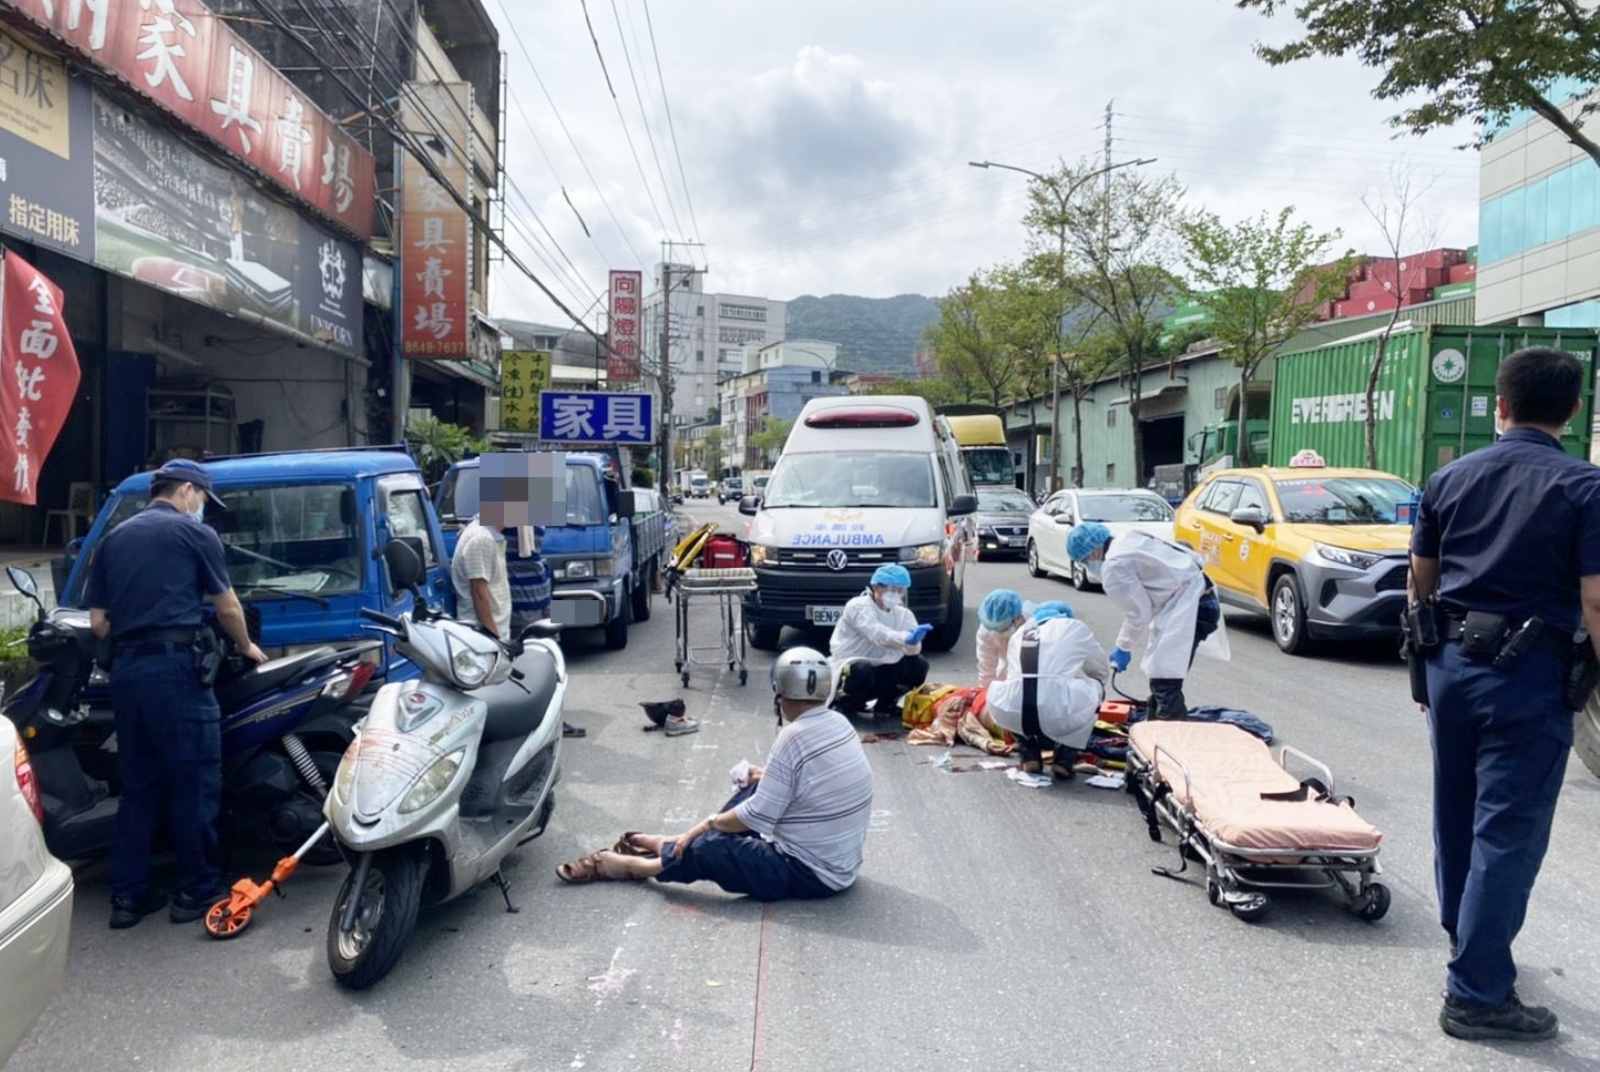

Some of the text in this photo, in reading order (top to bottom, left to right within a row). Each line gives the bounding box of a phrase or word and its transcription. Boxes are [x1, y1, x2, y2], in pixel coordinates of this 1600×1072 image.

[8, 192, 80, 247] 指定用床
[552, 395, 645, 440] 家具
